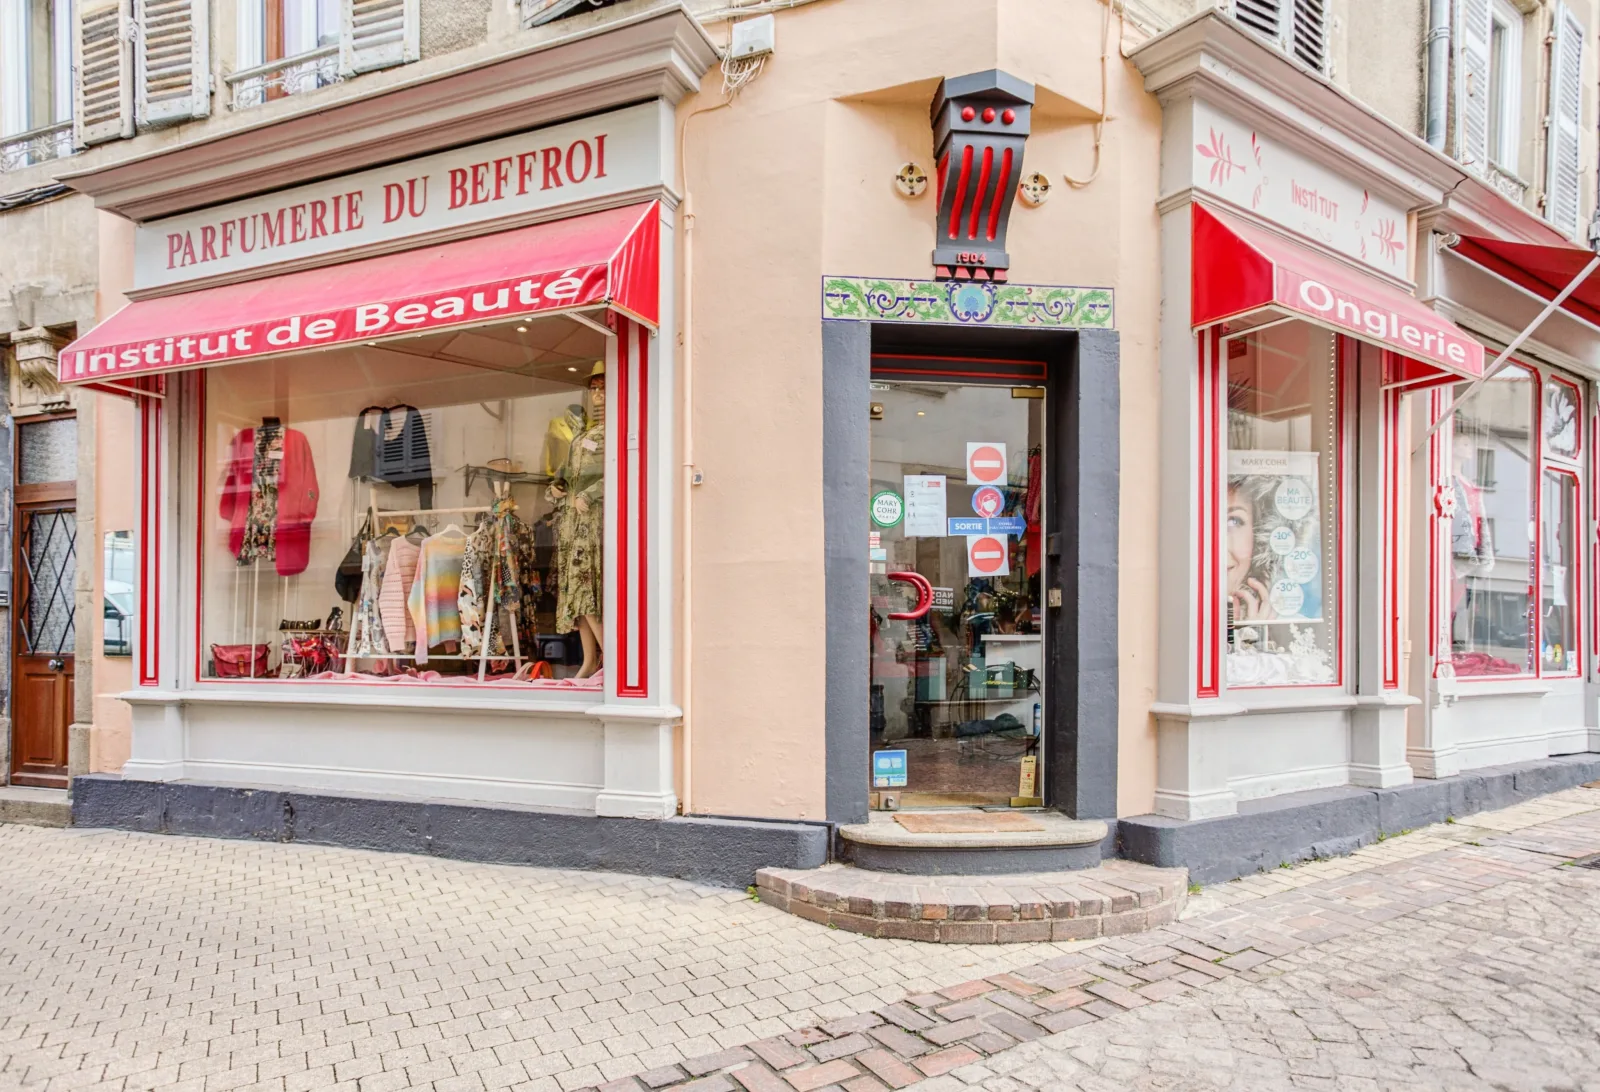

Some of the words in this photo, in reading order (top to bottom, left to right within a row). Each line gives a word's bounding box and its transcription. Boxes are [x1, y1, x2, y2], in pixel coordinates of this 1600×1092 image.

[167, 189, 365, 269] PARFUMERIE
[383, 175, 429, 224] DU
[448, 133, 608, 210] BEFFROI
[1291, 178, 1339, 223] INSTITUT
[956, 251, 987, 264] 1904
[74, 327, 254, 375] Institut
[266, 312, 336, 345] de
[354, 268, 585, 332] Beauté
[1299, 280, 1466, 364] Onglerie
[1241, 458, 1264, 466] MARY
[877, 499, 898, 507] MARY
[954, 522, 983, 531] SORTIE
